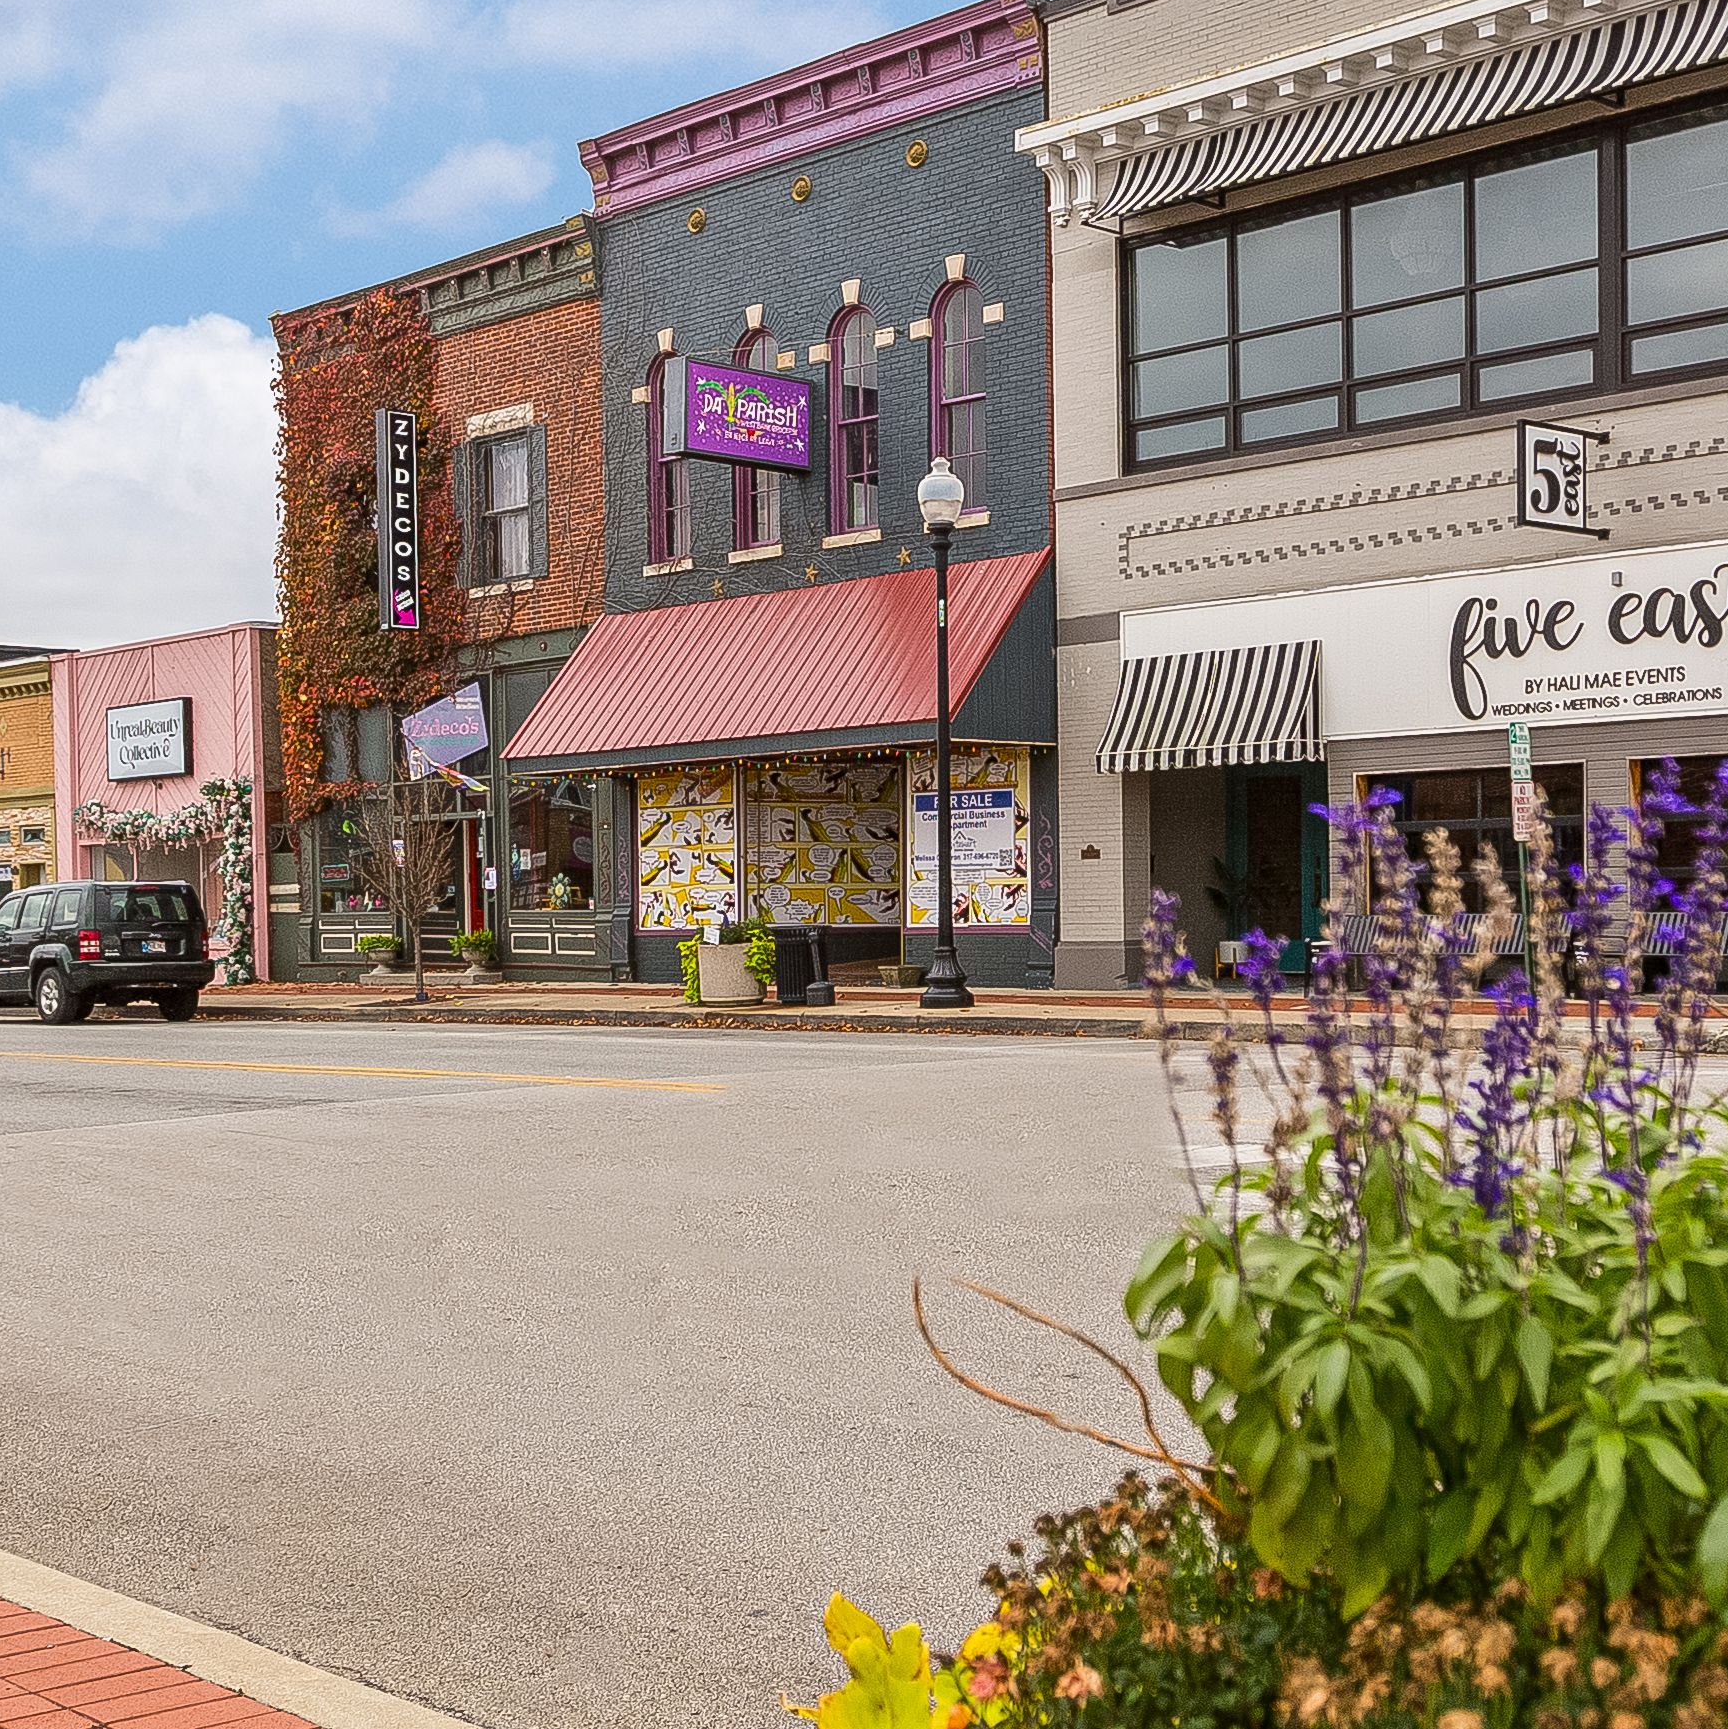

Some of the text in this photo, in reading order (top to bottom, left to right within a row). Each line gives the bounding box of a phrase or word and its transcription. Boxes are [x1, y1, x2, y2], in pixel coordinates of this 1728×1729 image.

[704, 393, 724, 415] DA
[1530, 437, 1583, 517] 5 east
[394, 419, 413, 581] ZYDECOS
[1449, 596, 1584, 720] five
[1524, 666, 1686, 694] BY HALI MAE EVENTS
[1491, 687, 1723, 717] WEDDINGS MEETINGS CELEBRATIONS
[110, 717, 180, 742] Unreal Beauty
[119, 738, 171, 769] Collective
[933, 793, 993, 809] FR SALE
[969, 809, 1006, 820] Business
[950, 819, 988, 831] partment
